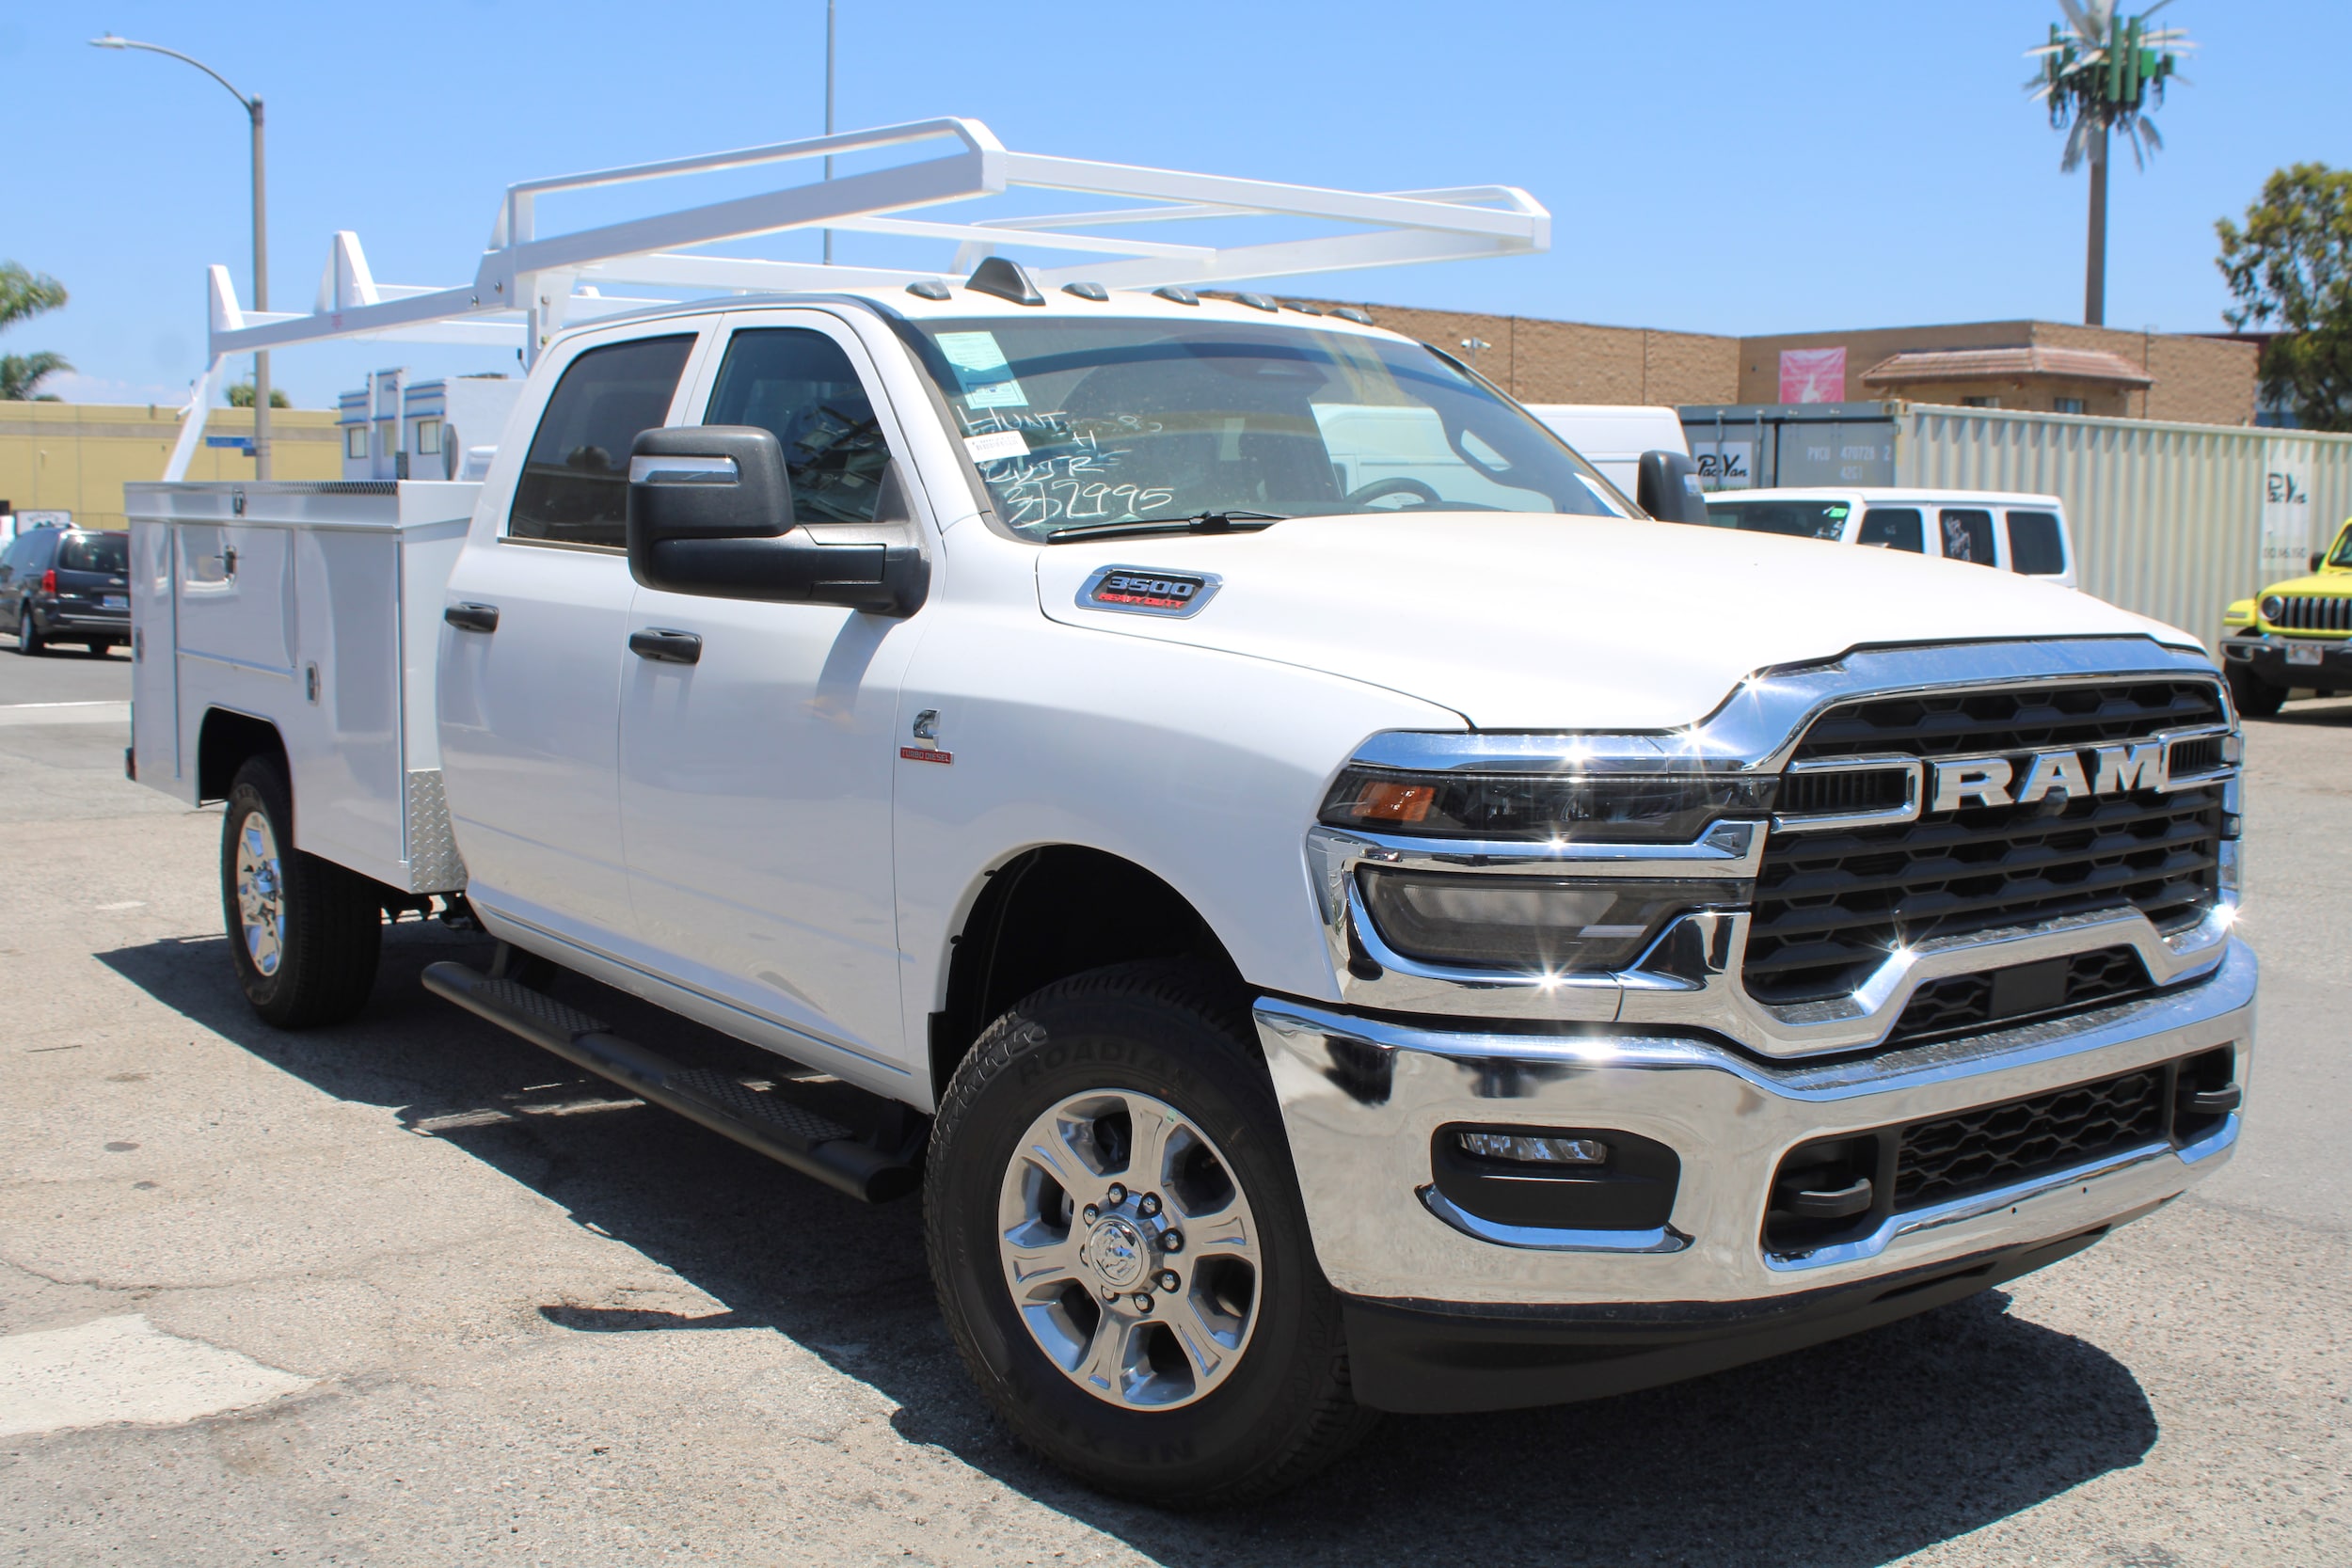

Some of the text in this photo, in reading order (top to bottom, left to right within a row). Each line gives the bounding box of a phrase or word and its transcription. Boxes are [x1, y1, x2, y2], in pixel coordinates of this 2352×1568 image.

[1883, 445, 1892, 461] 2
[1107, 576, 1195, 597] 3500
[1098, 593, 1185, 609] HEAVY DUTY
[901, 749, 950, 763] TURBO DIESEL
[1931, 742, 2162, 812] RAM
[1017, 1038, 1197, 1093] ROADIAN
